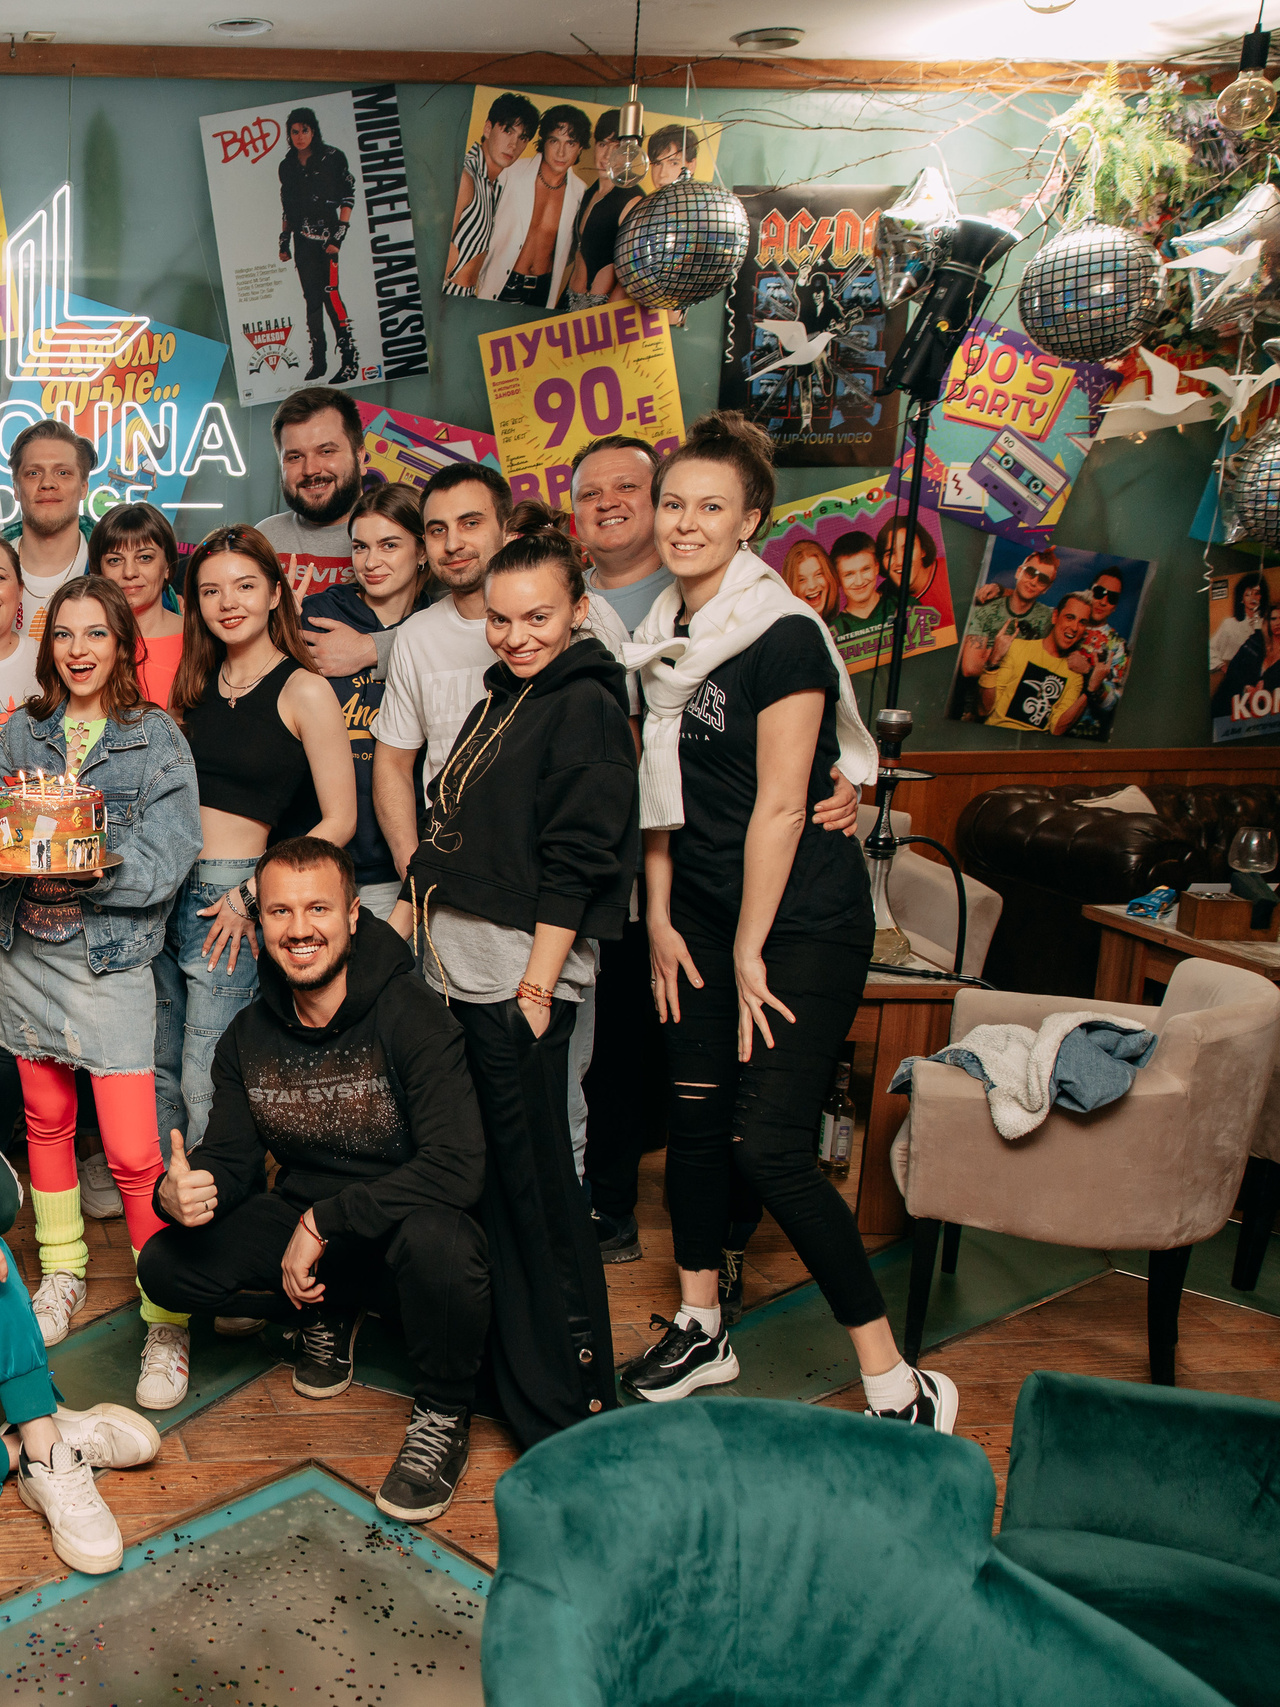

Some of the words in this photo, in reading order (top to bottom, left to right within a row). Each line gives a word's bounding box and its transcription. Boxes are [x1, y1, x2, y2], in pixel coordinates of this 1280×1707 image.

[212, 117, 281, 164] BAD
[351, 83, 413, 233] MICHAEL
[242, 317, 292, 334] MICHAEL
[370, 233, 430, 381] JACKSON
[253, 331, 285, 345] JACKSON
[490, 305, 663, 377] ЛУЧШЕЕ
[962, 336, 1062, 395] 90'S
[946, 378, 1049, 426] PARTY
[802, 432, 834, 444] YOUR
[836, 431, 873, 444] VIDEO
[248, 1087, 302, 1104] STAR
